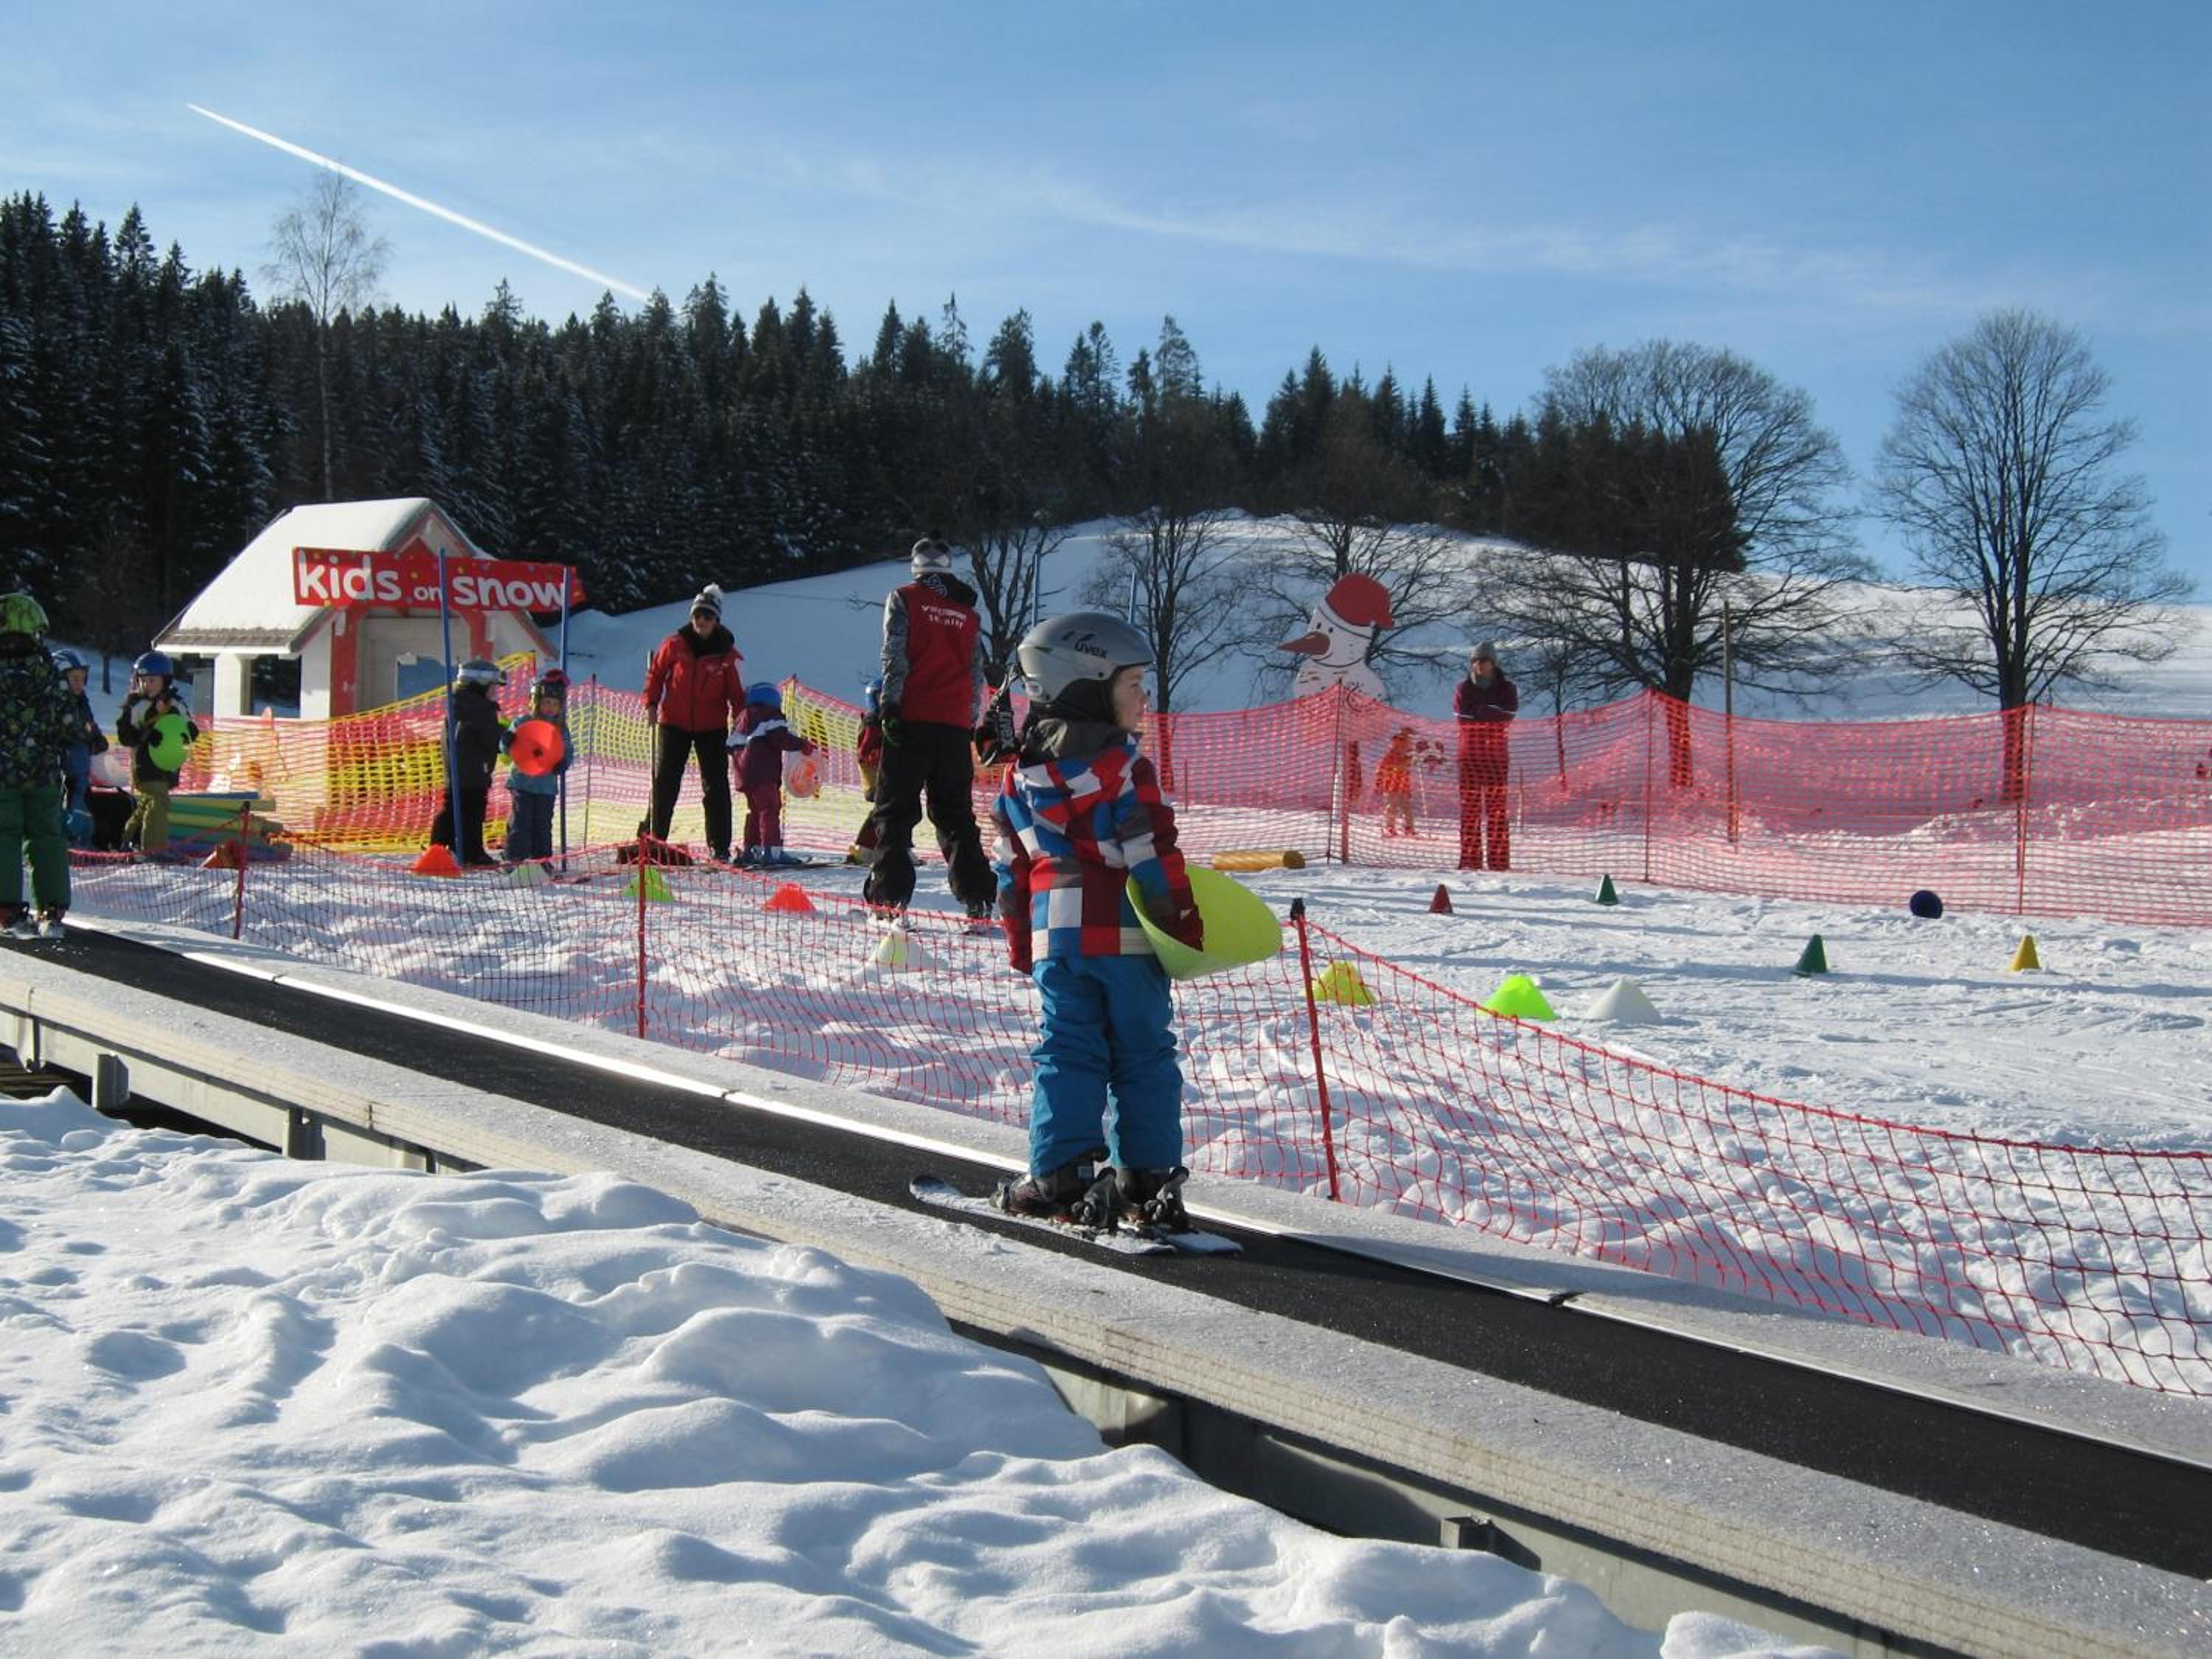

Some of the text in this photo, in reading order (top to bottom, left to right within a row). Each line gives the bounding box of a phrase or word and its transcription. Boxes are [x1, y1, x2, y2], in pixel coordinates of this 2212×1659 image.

[299, 549, 565, 608] kids on snow
[1074, 642, 1108, 659] uvex
